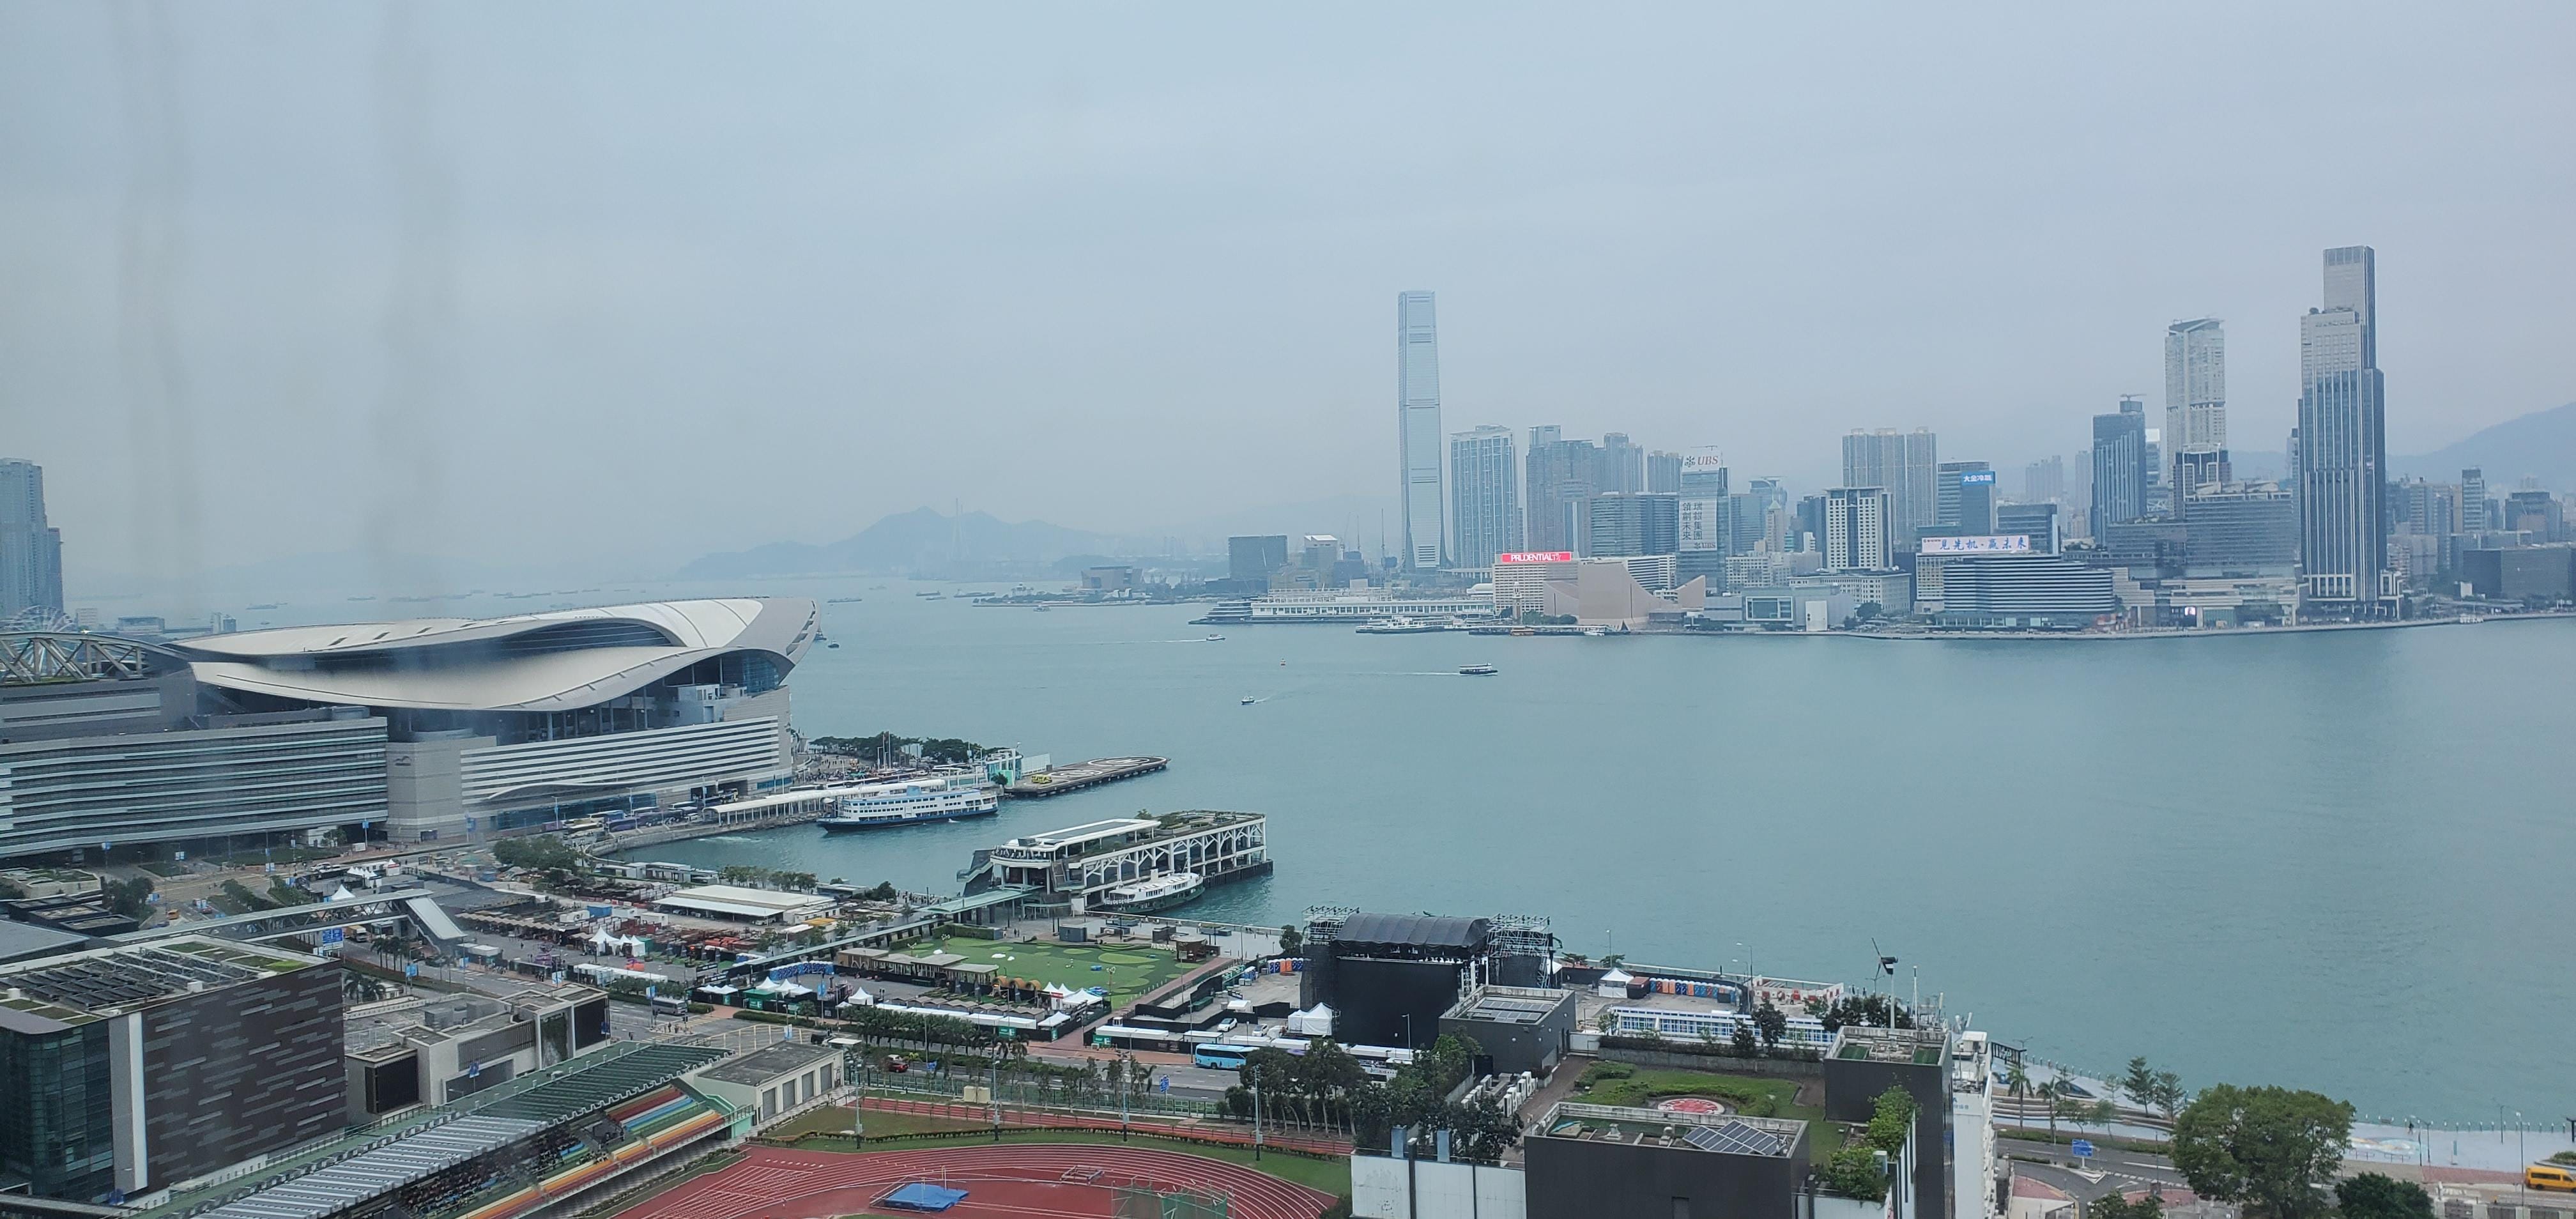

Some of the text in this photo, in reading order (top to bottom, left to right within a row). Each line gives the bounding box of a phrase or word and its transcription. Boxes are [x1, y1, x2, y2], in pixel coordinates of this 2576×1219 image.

[1697, 456, 1718, 466] UBS
[1682, 502, 1692, 540] 領創未來
[1693, 502, 1703, 540] 瑞銀集團
[1510, 553, 1552, 562] PRUDENTIAL
